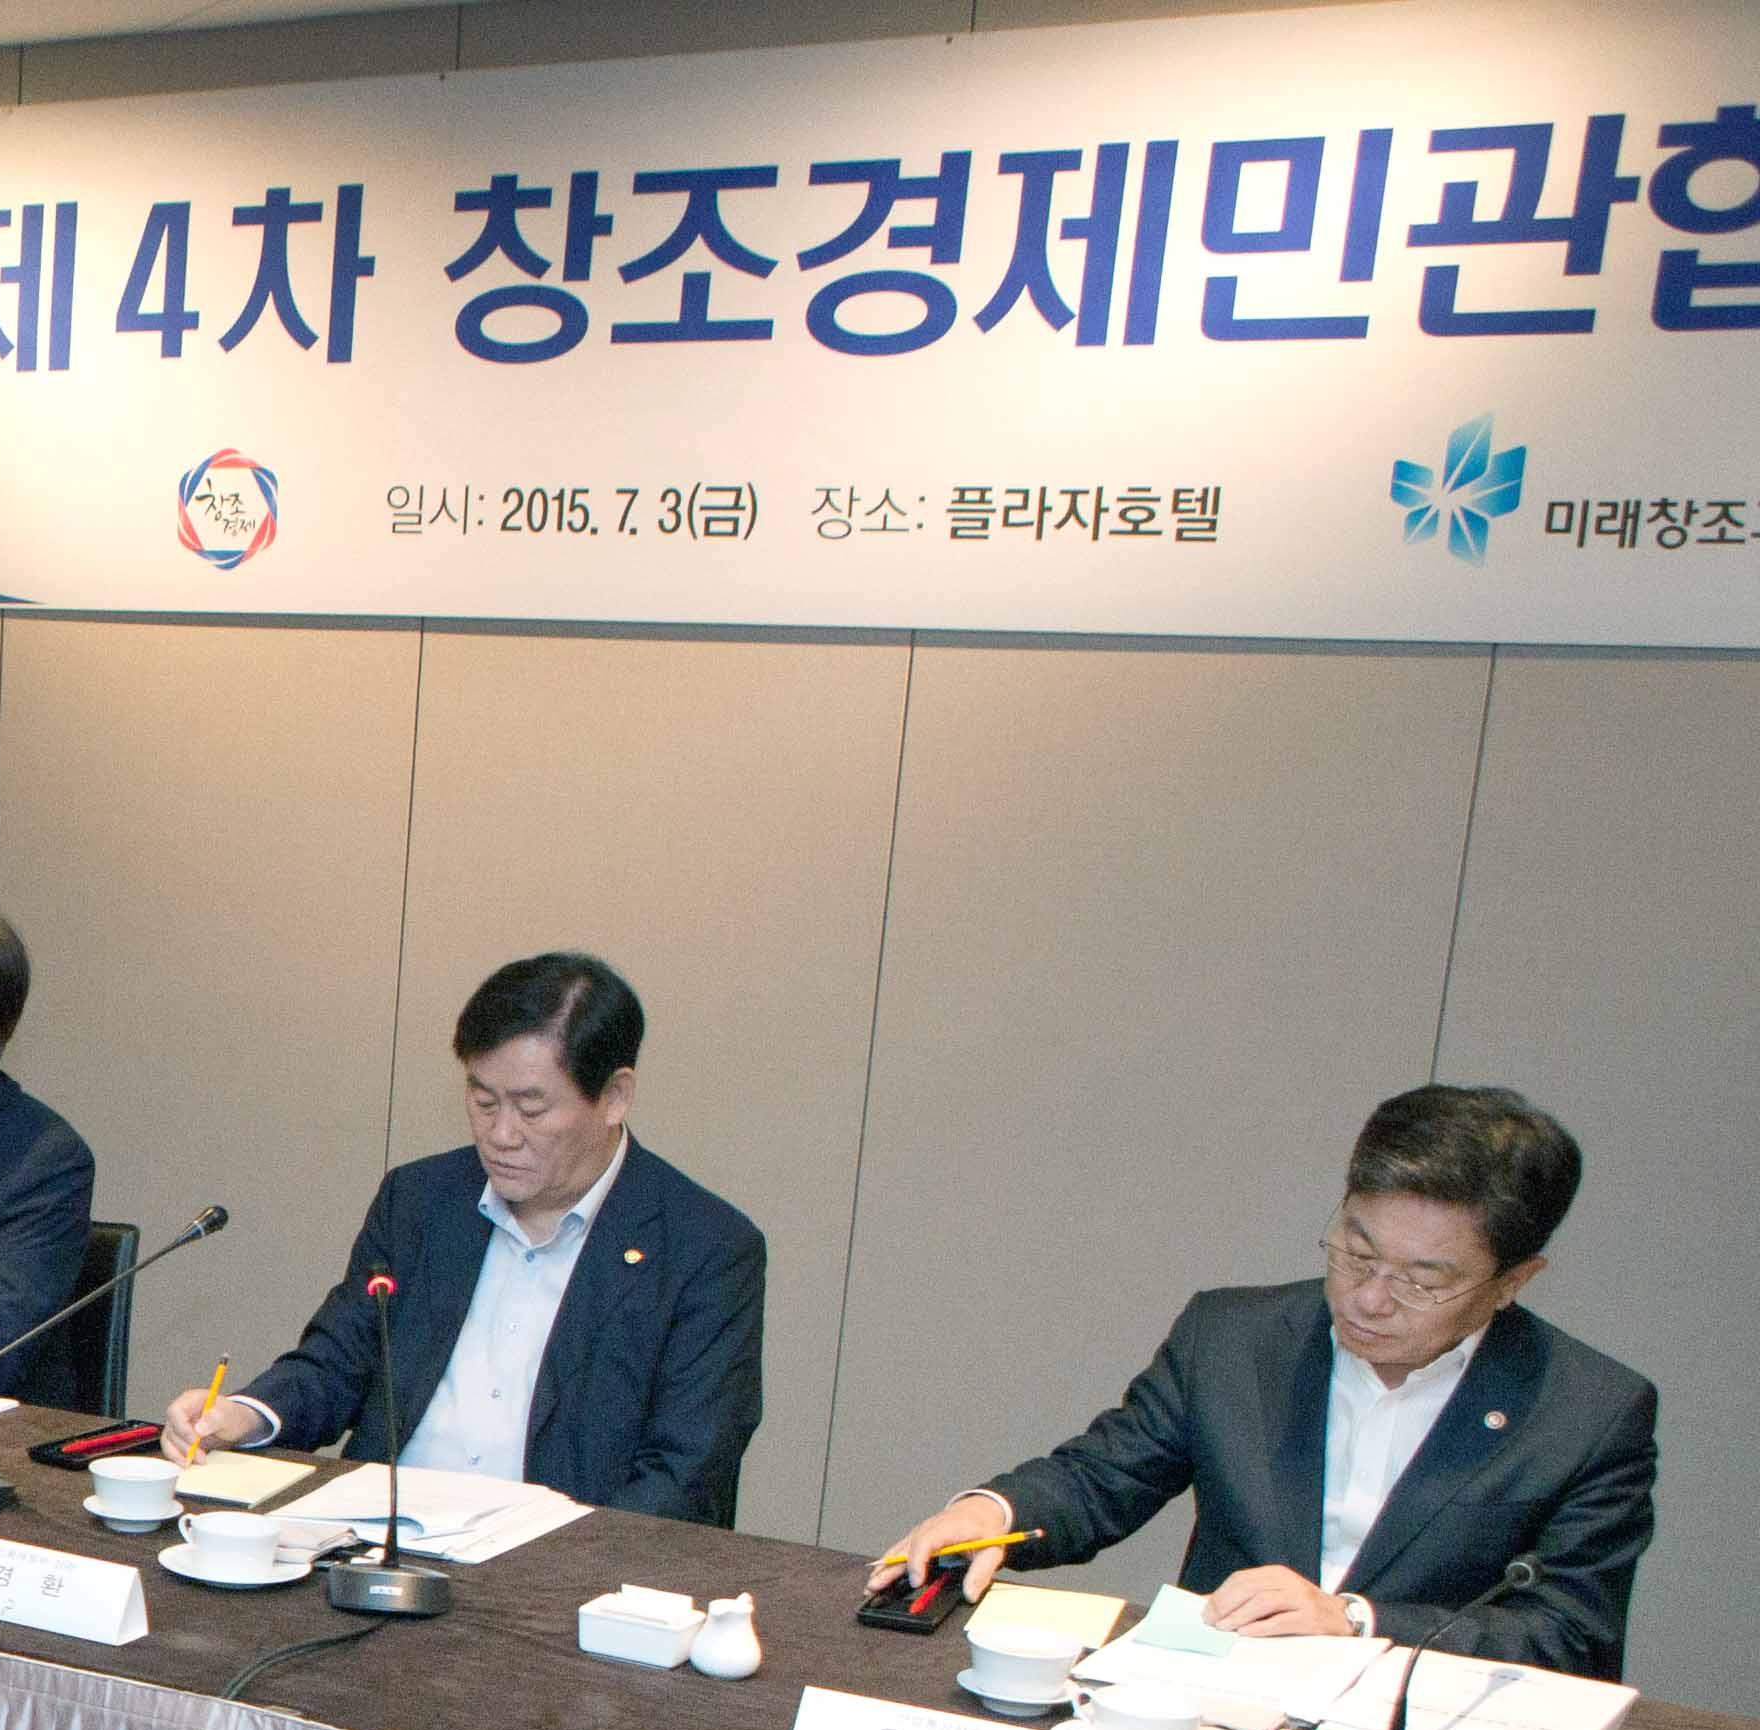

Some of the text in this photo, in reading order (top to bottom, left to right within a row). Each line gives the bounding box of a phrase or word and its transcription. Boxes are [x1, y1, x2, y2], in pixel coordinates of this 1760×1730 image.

[195, 477, 246, 521] 창조
[386, 483, 485, 536] 일시:
[810, 484, 927, 541] 장소:
[945, 485, 1224, 543] 플라자호텔
[223, 517, 257, 537] 경제
[1544, 497, 1760, 550] 미래창조
